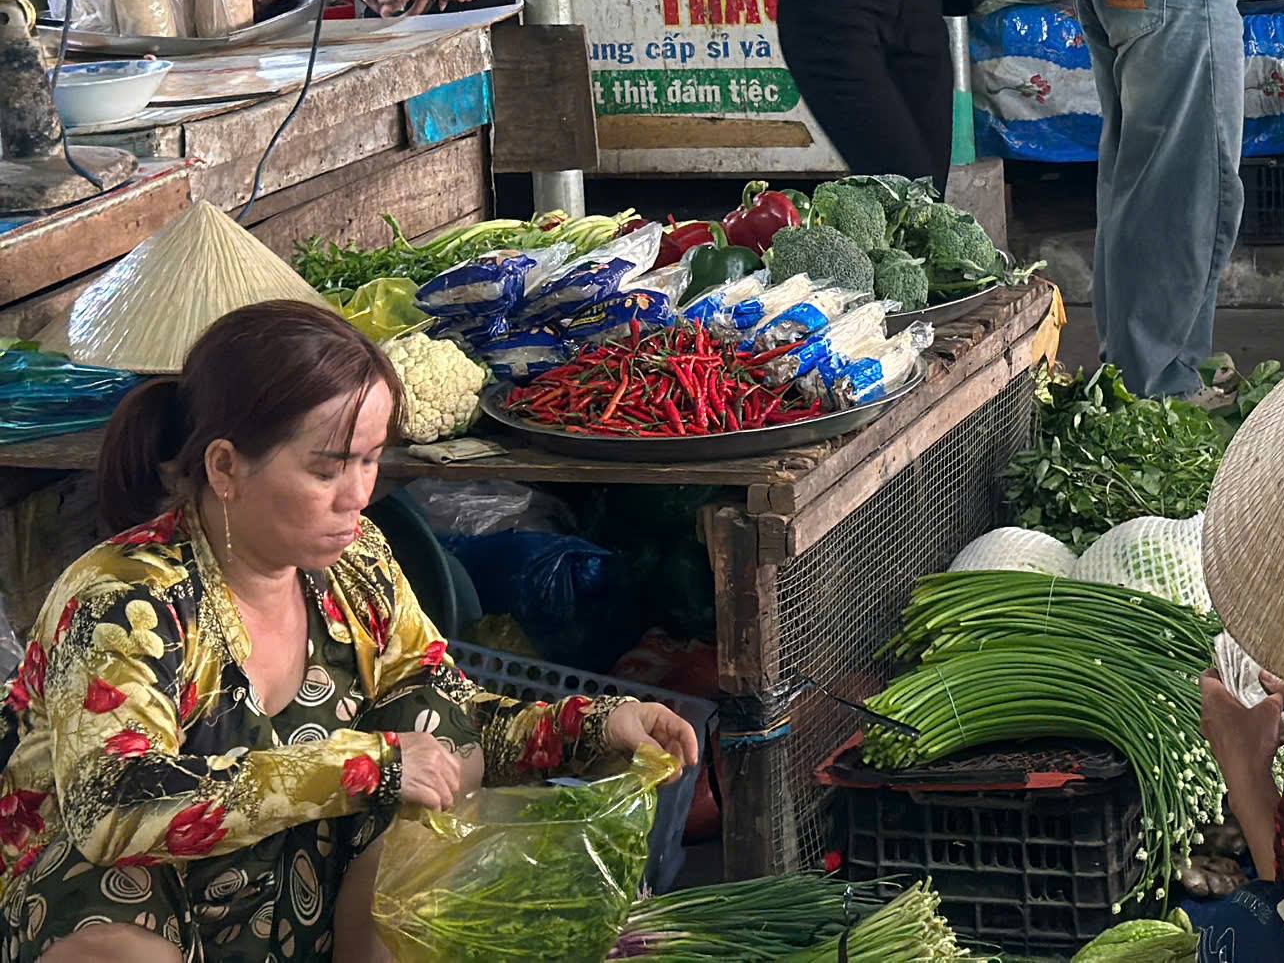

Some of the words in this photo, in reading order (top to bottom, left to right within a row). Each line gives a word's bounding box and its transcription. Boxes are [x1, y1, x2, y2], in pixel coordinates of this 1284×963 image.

[589, 41, 634, 65] ung
[645, 32, 695, 64] cấp
[740, 34, 771, 58] và
[613, 79, 658, 109] thịt
[667, 79, 722, 104] đám
[728, 78, 779, 108] tiệc
